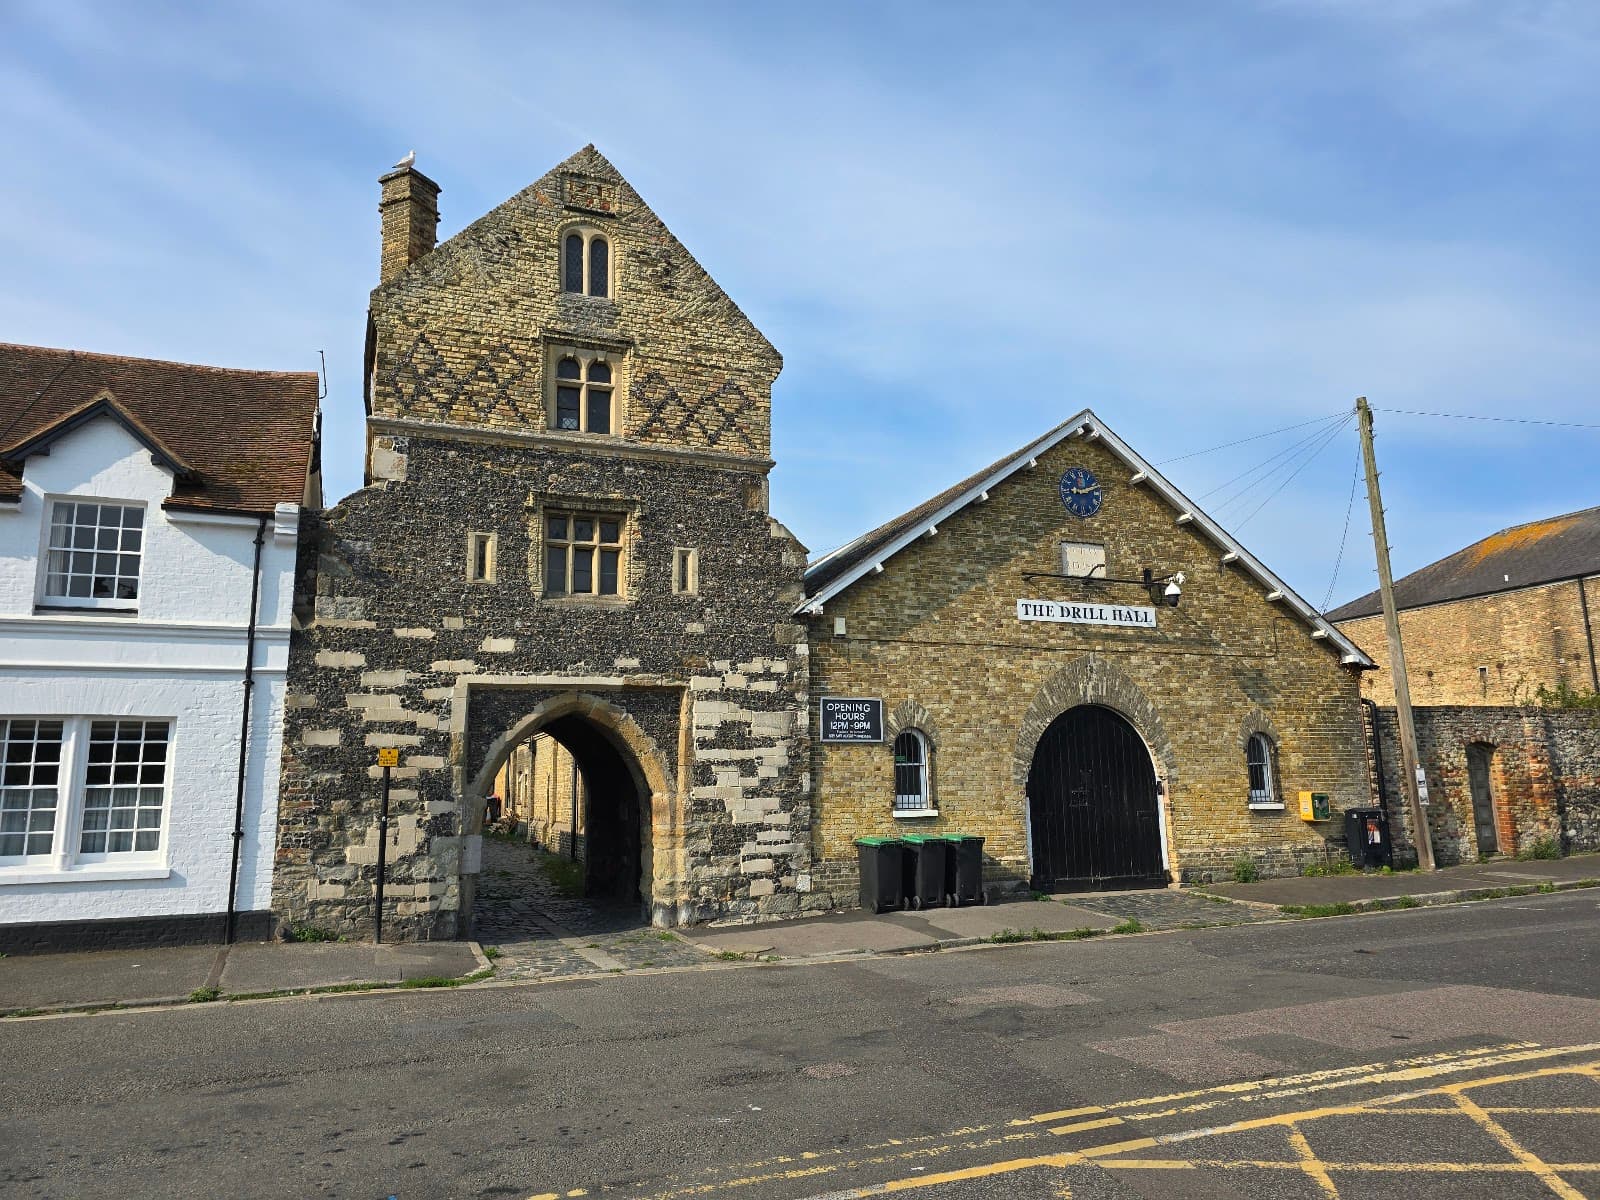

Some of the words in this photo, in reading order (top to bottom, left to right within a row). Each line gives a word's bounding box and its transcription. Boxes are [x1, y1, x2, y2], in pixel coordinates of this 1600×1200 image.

[1022, 603, 1054, 617] THE
[1059, 606, 1107, 620] DRILL
[1112, 609, 1152, 623] HALL
[827, 703, 871, 712] OPENING
[835, 712, 866, 721] HOURS
[830, 721, 849, 730] 12PM
